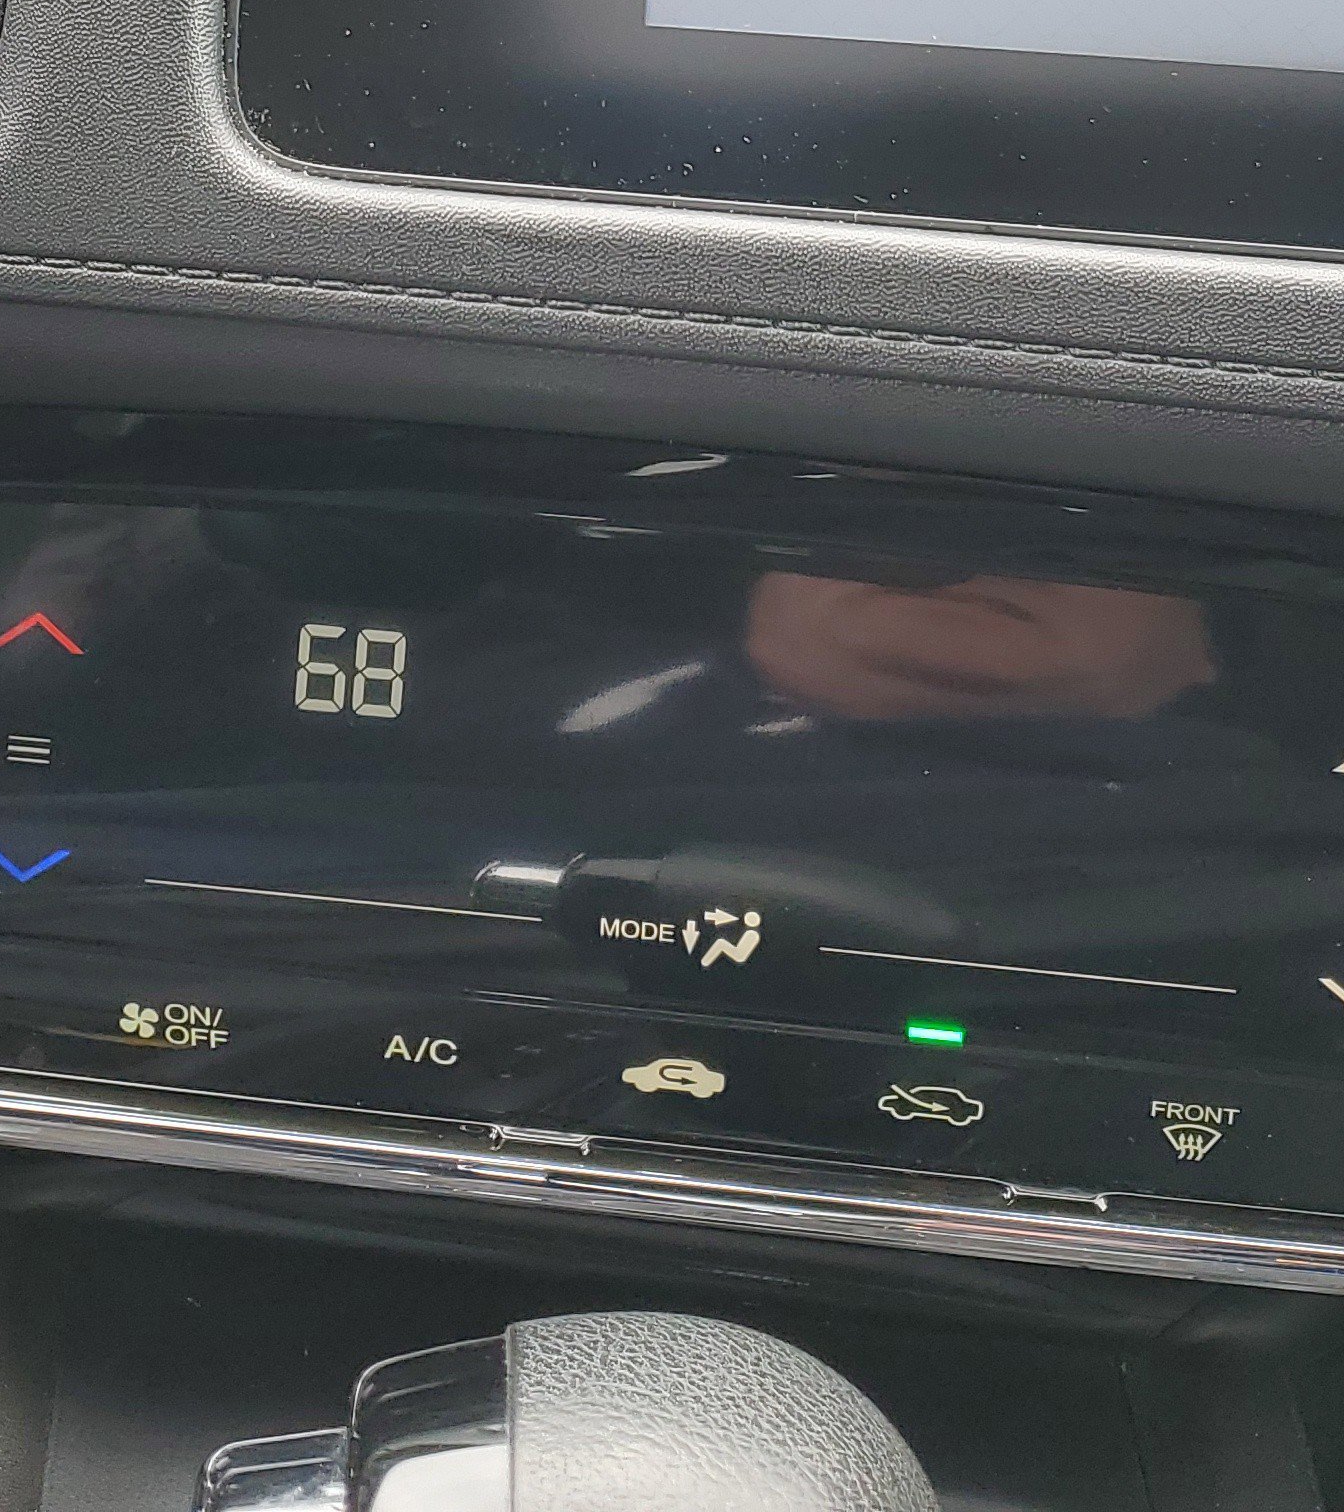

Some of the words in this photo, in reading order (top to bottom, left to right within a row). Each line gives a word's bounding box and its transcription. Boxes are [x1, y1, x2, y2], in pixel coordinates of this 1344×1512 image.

[294, 623, 407, 719] 68
[599, 916, 676, 944] MODE
[163, 1002, 224, 1028] ON/
[163, 1024, 230, 1049] OFF
[383, 1034, 458, 1066] A/C
[1149, 1100, 1241, 1126] FRONT
